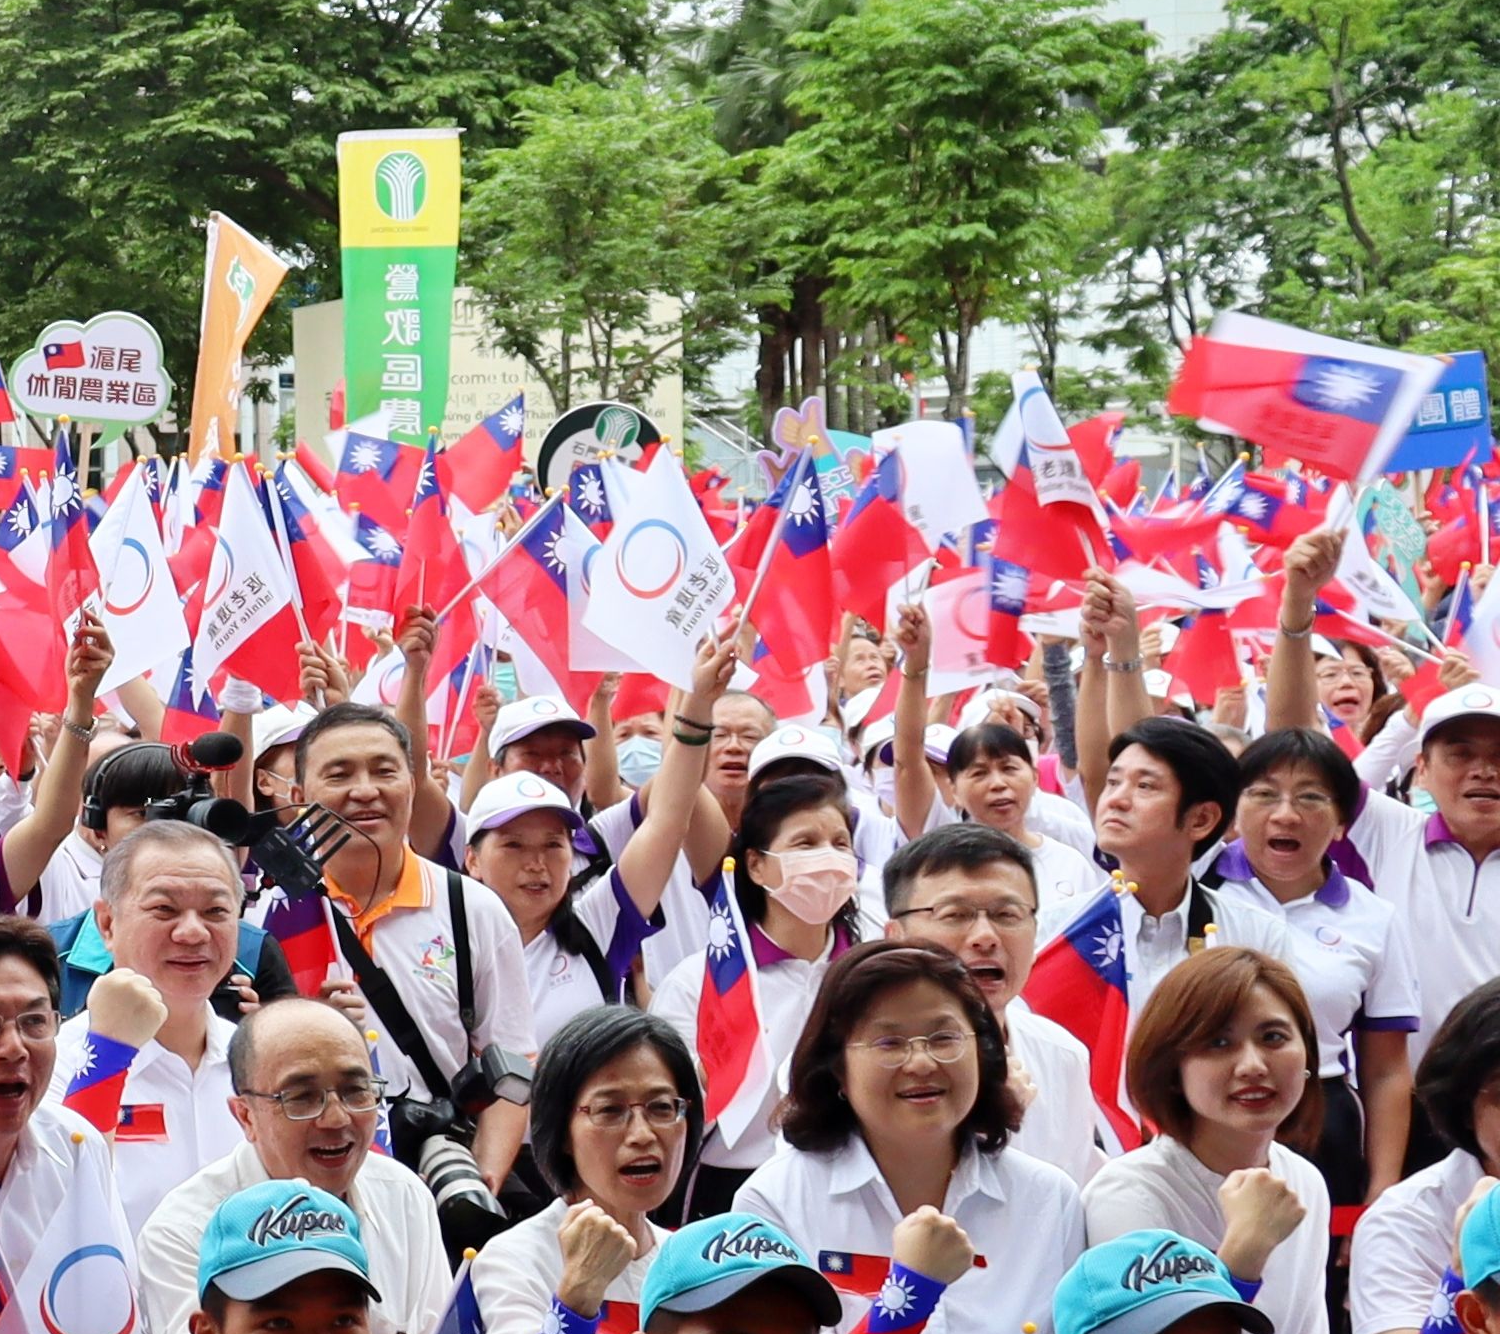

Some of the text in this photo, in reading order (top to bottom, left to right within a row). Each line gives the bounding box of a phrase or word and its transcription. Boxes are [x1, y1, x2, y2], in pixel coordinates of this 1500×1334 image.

[89, 346, 142, 373] 滬尾
[26, 373, 158, 407] 休閒農業區
[246, 1192, 346, 1248] Kupao
[702, 1219, 803, 1264] Kupao
